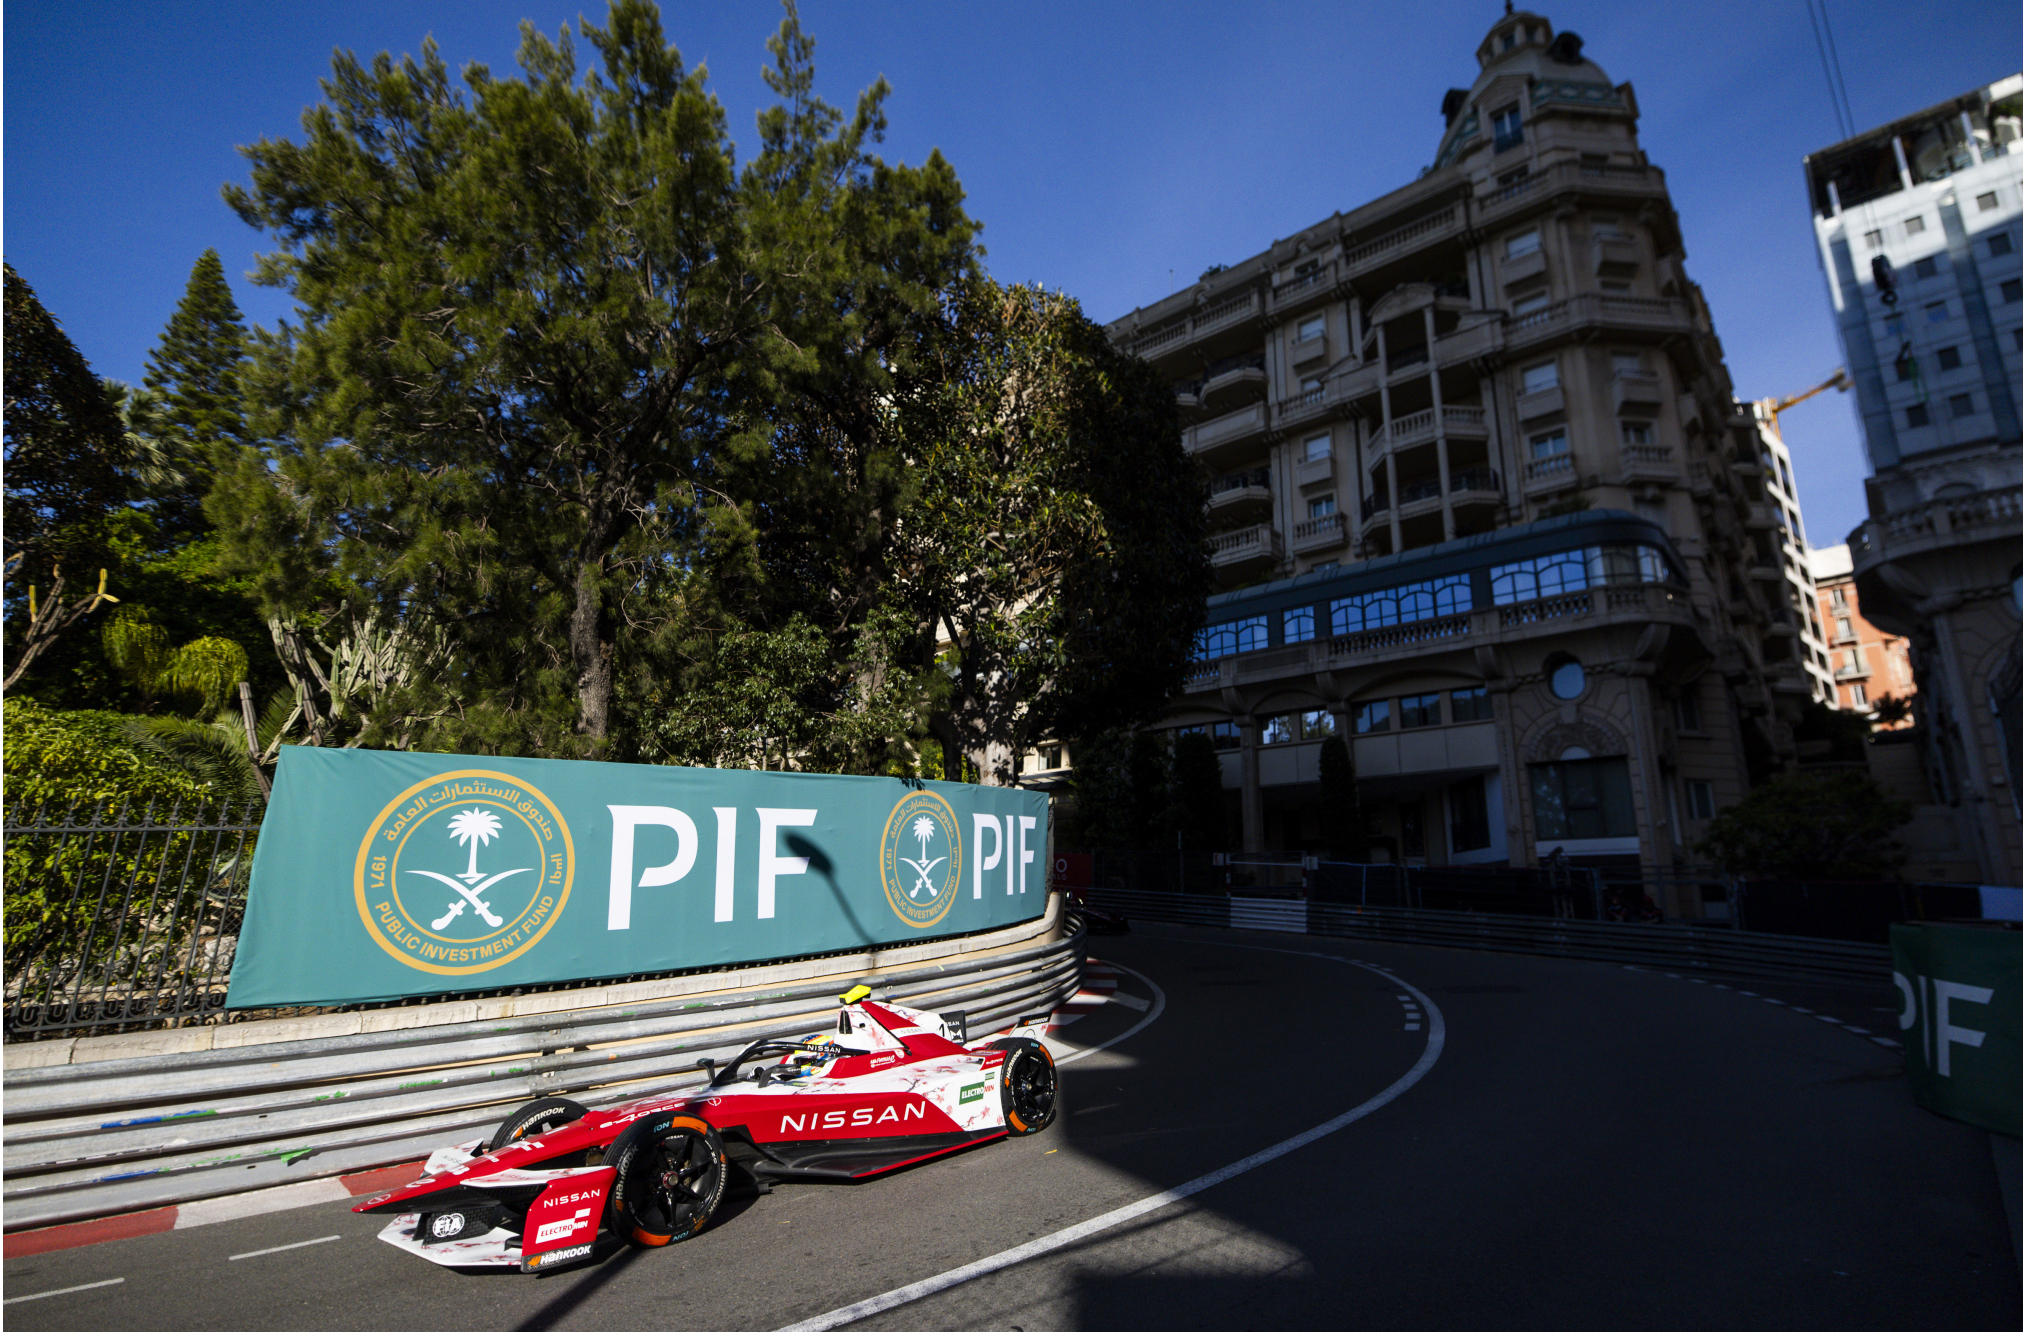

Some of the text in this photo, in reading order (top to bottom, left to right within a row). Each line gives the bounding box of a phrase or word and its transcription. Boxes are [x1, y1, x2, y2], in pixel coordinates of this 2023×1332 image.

[517, 799, 553, 842] صندوق
[370, 855, 387, 889] 1971
[606, 805, 818, 931] PIF
[972, 813, 1037, 900] PIF
[888, 875, 956, 919] PUBLIC INVESTMENT FUND
[375, 895, 554, 962] PUBLIC INVESTMENT FUND
[807, 1044, 841, 1054] NISSAN
[780, 1100, 926, 1134] NISSAN
[543, 1188, 601, 1209] NISSAN
[540, 1220, 589, 1237] ELECTROMIN
